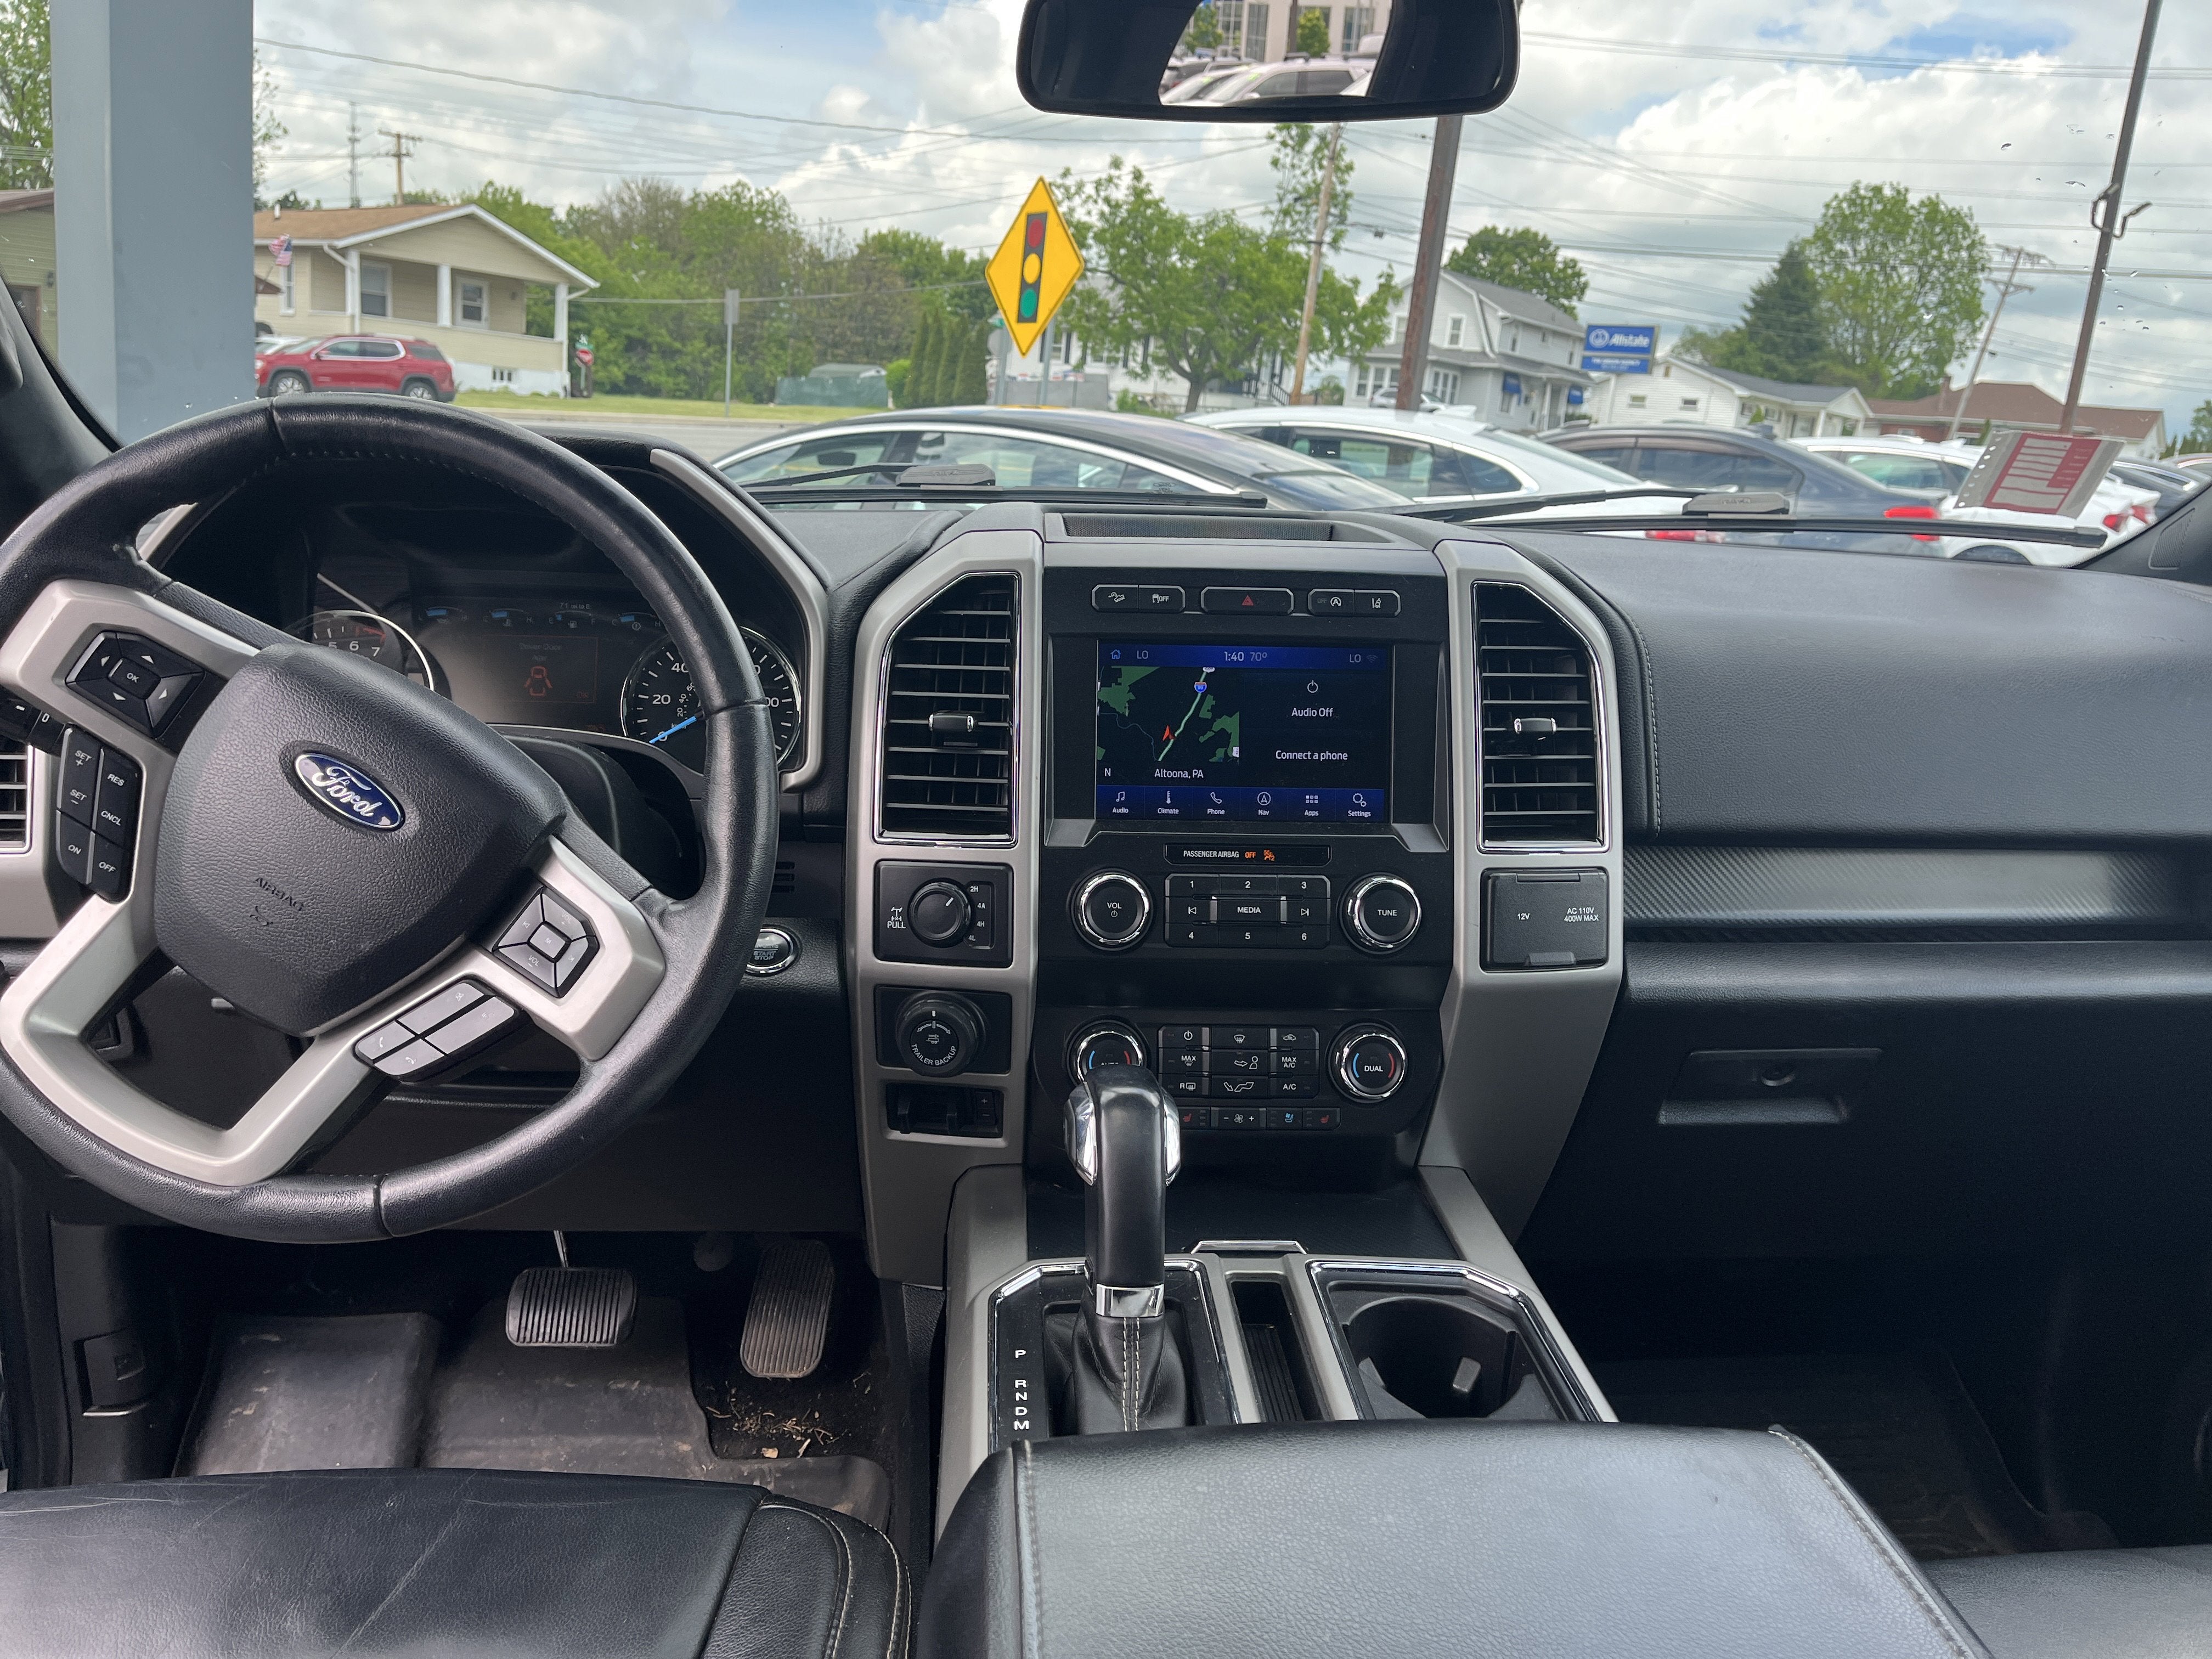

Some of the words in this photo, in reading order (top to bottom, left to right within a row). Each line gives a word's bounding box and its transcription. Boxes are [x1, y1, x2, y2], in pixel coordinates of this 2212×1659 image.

[1610, 333, 1650, 348] Allstate
[349, 641, 359, 651] 6
[371, 646, 380, 657] 7
[1137, 650, 1149, 659] LO
[1224, 651, 1244, 662] 1:40
[1350, 654, 1361, 663] LO
[671, 663, 689, 673] 40
[127, 673, 139, 683] OK
[652, 694, 671, 705] 20
[679, 693, 686, 703] 40
[677, 707, 684, 717] 20
[1291, 708, 1317, 717] Audio
[1319, 708, 1333, 717] Off
[75, 751, 92, 761] SET
[1276, 751, 1311, 760] Connect
[1321, 751, 1348, 761] phone
[1104, 768, 1111, 777] N
[1154, 769, 1190, 778] Altoona,
[1193, 769, 1204, 778] PA
[108, 774, 125, 786] RES
[70, 789, 87, 801] SET
[312, 766, 383, 817] Ford
[101, 810, 121, 826] CNCL
[1348, 810, 1371, 818] Settings
[68, 844, 81, 855] ON
[99, 861, 116, 873] OFF
[561, 912, 572, 923] VOL
[528, 955, 540, 967] VOL
[911, 1043, 933, 1065] TRAILER
[935, 1046, 957, 1066] BACKUP
[1015, 1350, 1026, 1358] P
[1015, 1380, 1026, 1388] R
[1015, 1392, 1027, 1401] N
[1015, 1407, 1028, 1416] D
[1014, 1420, 1029, 1430] M
